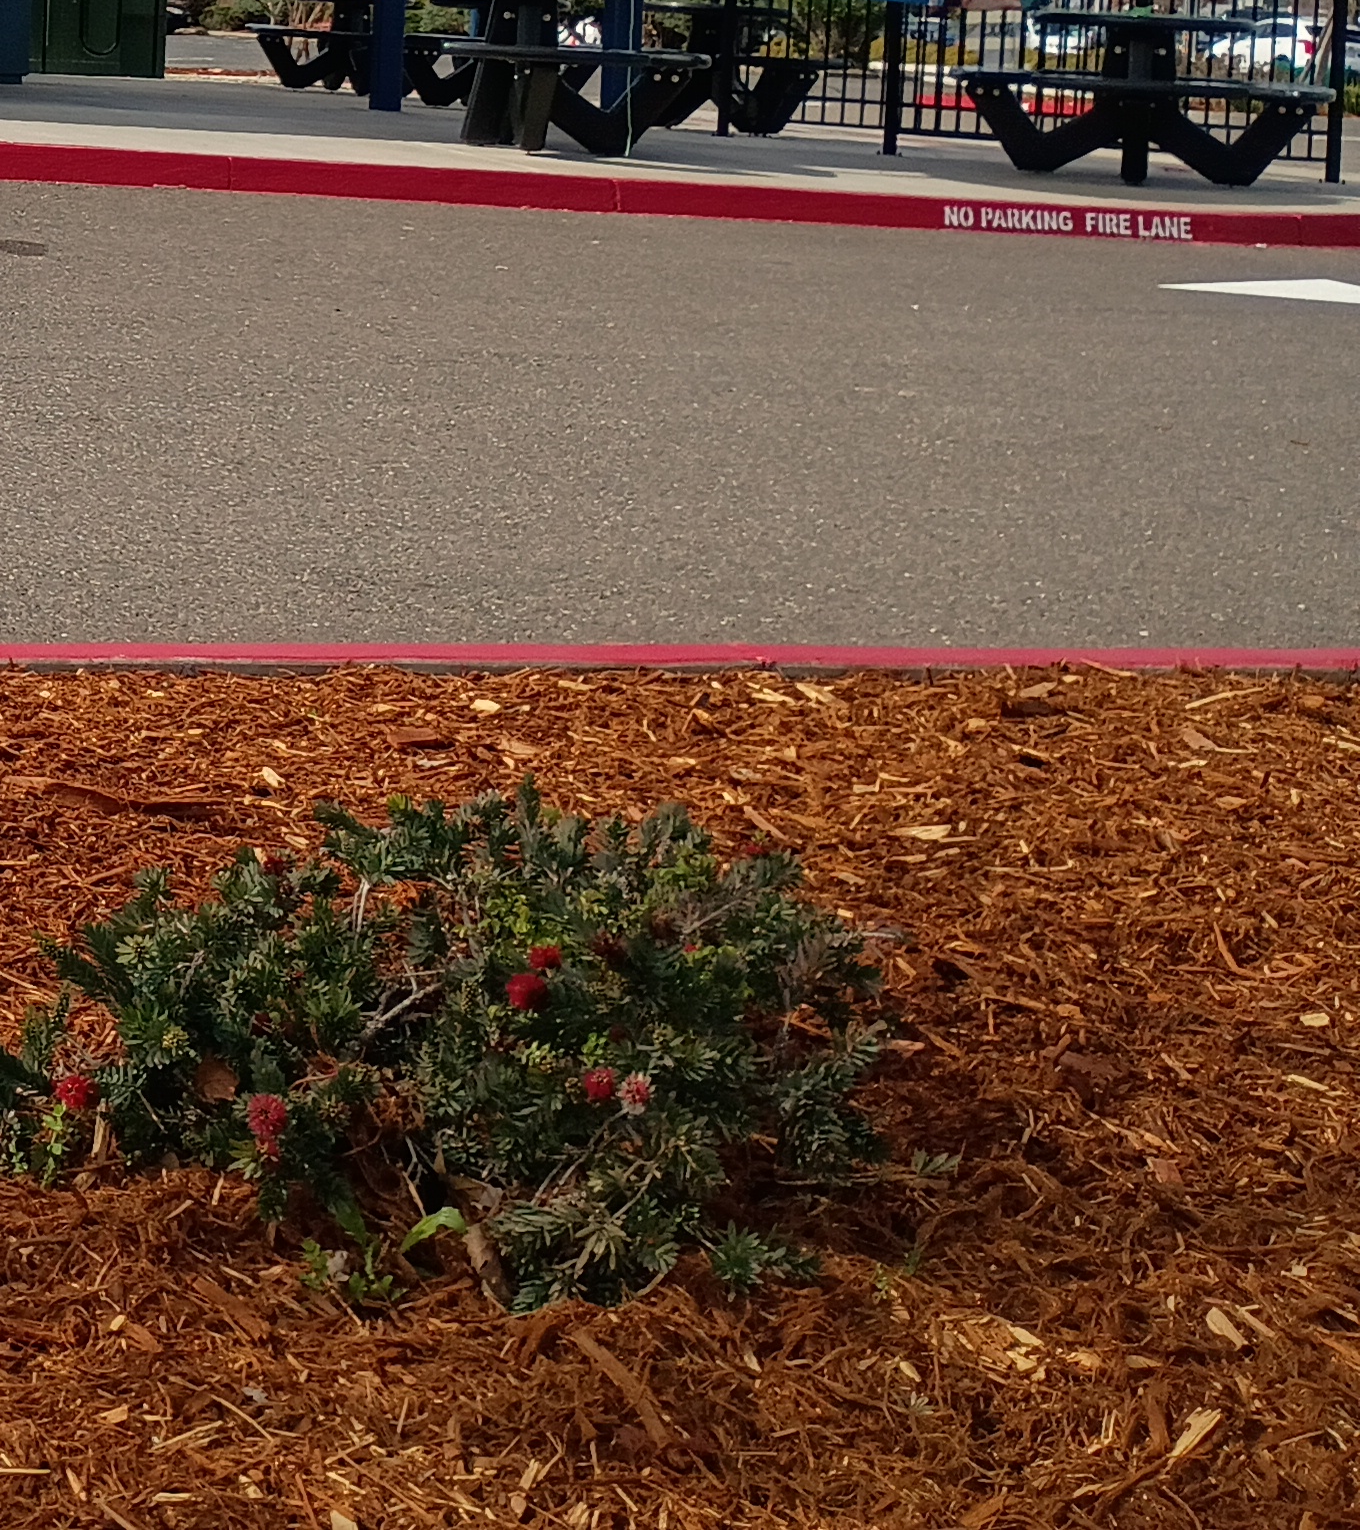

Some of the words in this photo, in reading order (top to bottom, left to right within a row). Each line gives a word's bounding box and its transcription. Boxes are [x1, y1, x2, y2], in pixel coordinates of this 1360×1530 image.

[943, 205, 974, 227] NO
[980, 207, 1074, 231] PARKING
[1085, 212, 1132, 236] FIRE
[1137, 215, 1193, 239] LANE
